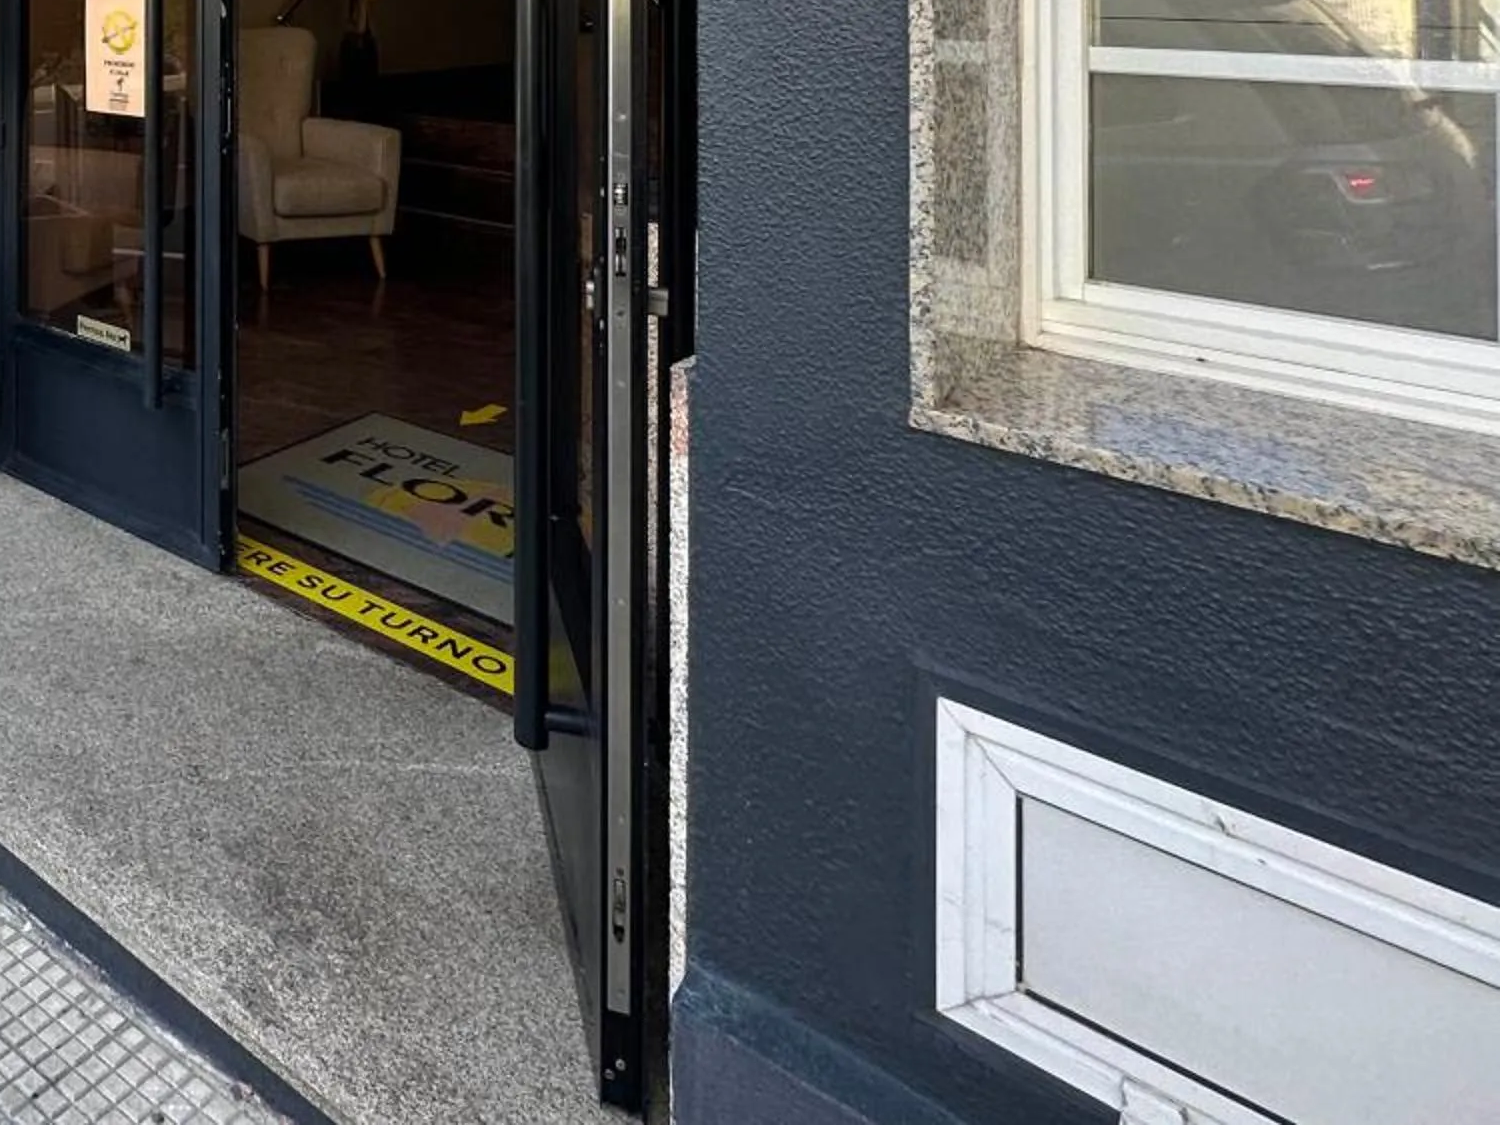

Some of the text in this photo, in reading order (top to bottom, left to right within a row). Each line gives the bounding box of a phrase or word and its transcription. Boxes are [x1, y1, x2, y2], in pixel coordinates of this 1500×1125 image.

[357, 436, 465, 478] HOTEL
[296, 574, 354, 601] SU
[356, 601, 507, 676] TURNO
